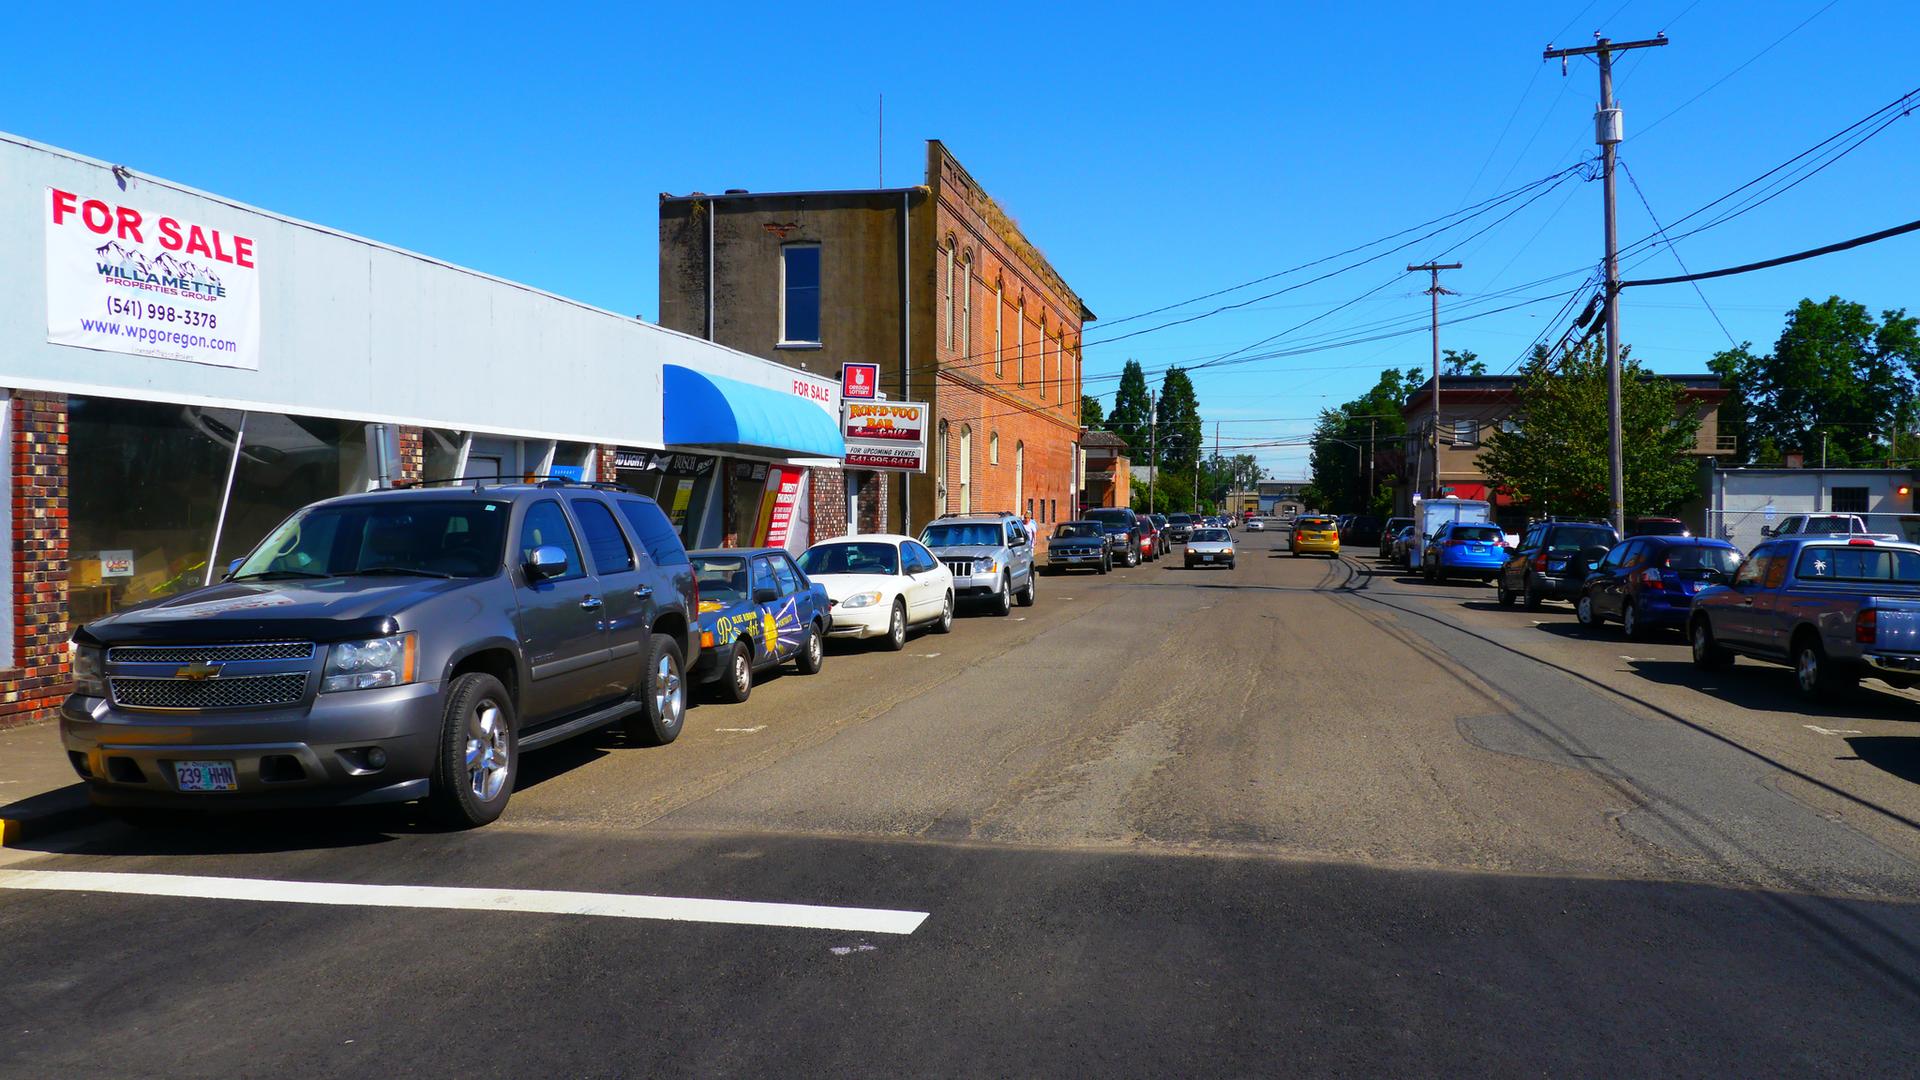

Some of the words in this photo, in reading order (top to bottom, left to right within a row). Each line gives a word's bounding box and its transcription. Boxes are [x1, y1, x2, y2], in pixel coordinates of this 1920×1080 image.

[52, 188, 144, 244] FOR
[158, 216, 255, 269] SALE
[96, 262, 226, 298] WILLAMETTE
[105, 276, 178, 296] PROPERTIES
[181, 290, 217, 302] GROUP
[107, 295, 142, 320] (541)
[147, 303, 217, 329] 998-3378
[80, 318, 237, 352] www.wpgoregon.com
[793, 380, 809, 398] FOR
[811, 384, 829, 402] SALE
[866, 418, 894, 429] BAR
[863, 448, 893, 456] UPCOMING
[178, 767, 201, 784] 239
[207, 767, 234, 784] HHN
